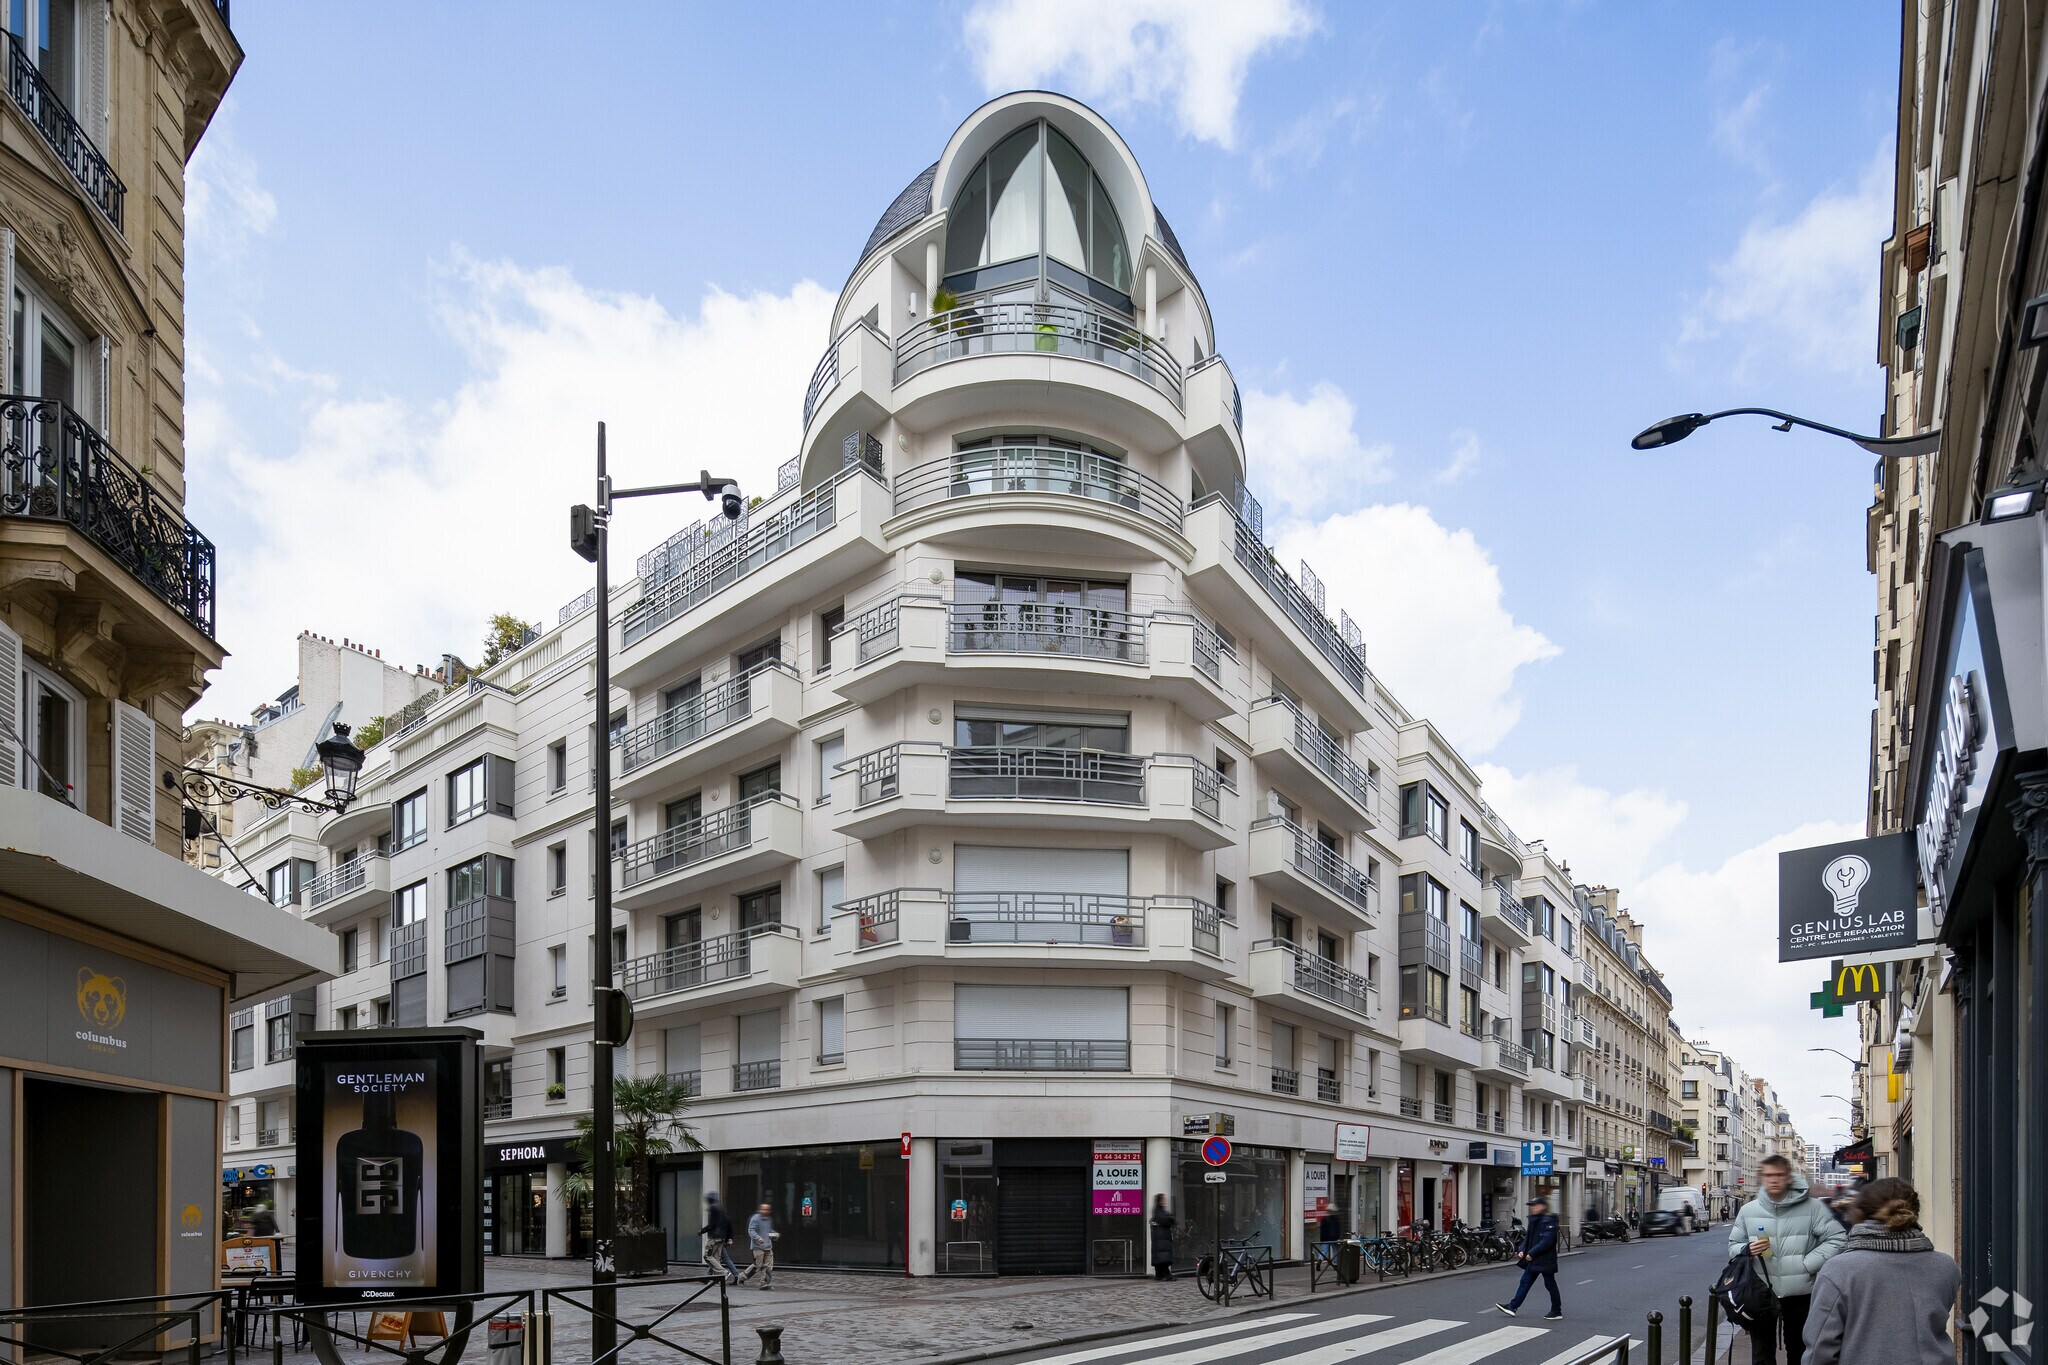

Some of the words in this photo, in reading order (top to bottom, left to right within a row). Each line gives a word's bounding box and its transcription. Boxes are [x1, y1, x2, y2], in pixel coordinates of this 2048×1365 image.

[1790, 915, 1863, 936] GENIUS
[1869, 910, 1905, 926] LAB
[1790, 934, 1826, 944] CENTRE
[1829, 931, 1841, 939] DE
[1844, 924, 1905, 937] REPARATION
[1821, 936, 1865, 946] SMARTPHONES
[1870, 931, 1904, 940] TABLETTES
[75, 1031, 127, 1049] columbus
[337, 1072, 425, 1084] GENTLEMAN
[354, 1084, 407, 1093] SOCIETY
[500, 1146, 545, 1161] SEPHORA
[1530, 1142, 1546, 1162] P
[1096, 1169, 1103, 1177] A
[1107, 1169, 1139, 1177] LOUER
[1305, 1171, 1310, 1180] A
[1310, 1171, 1326, 1180] LOUER
[348, 1270, 411, 1278] GIVENCHY
